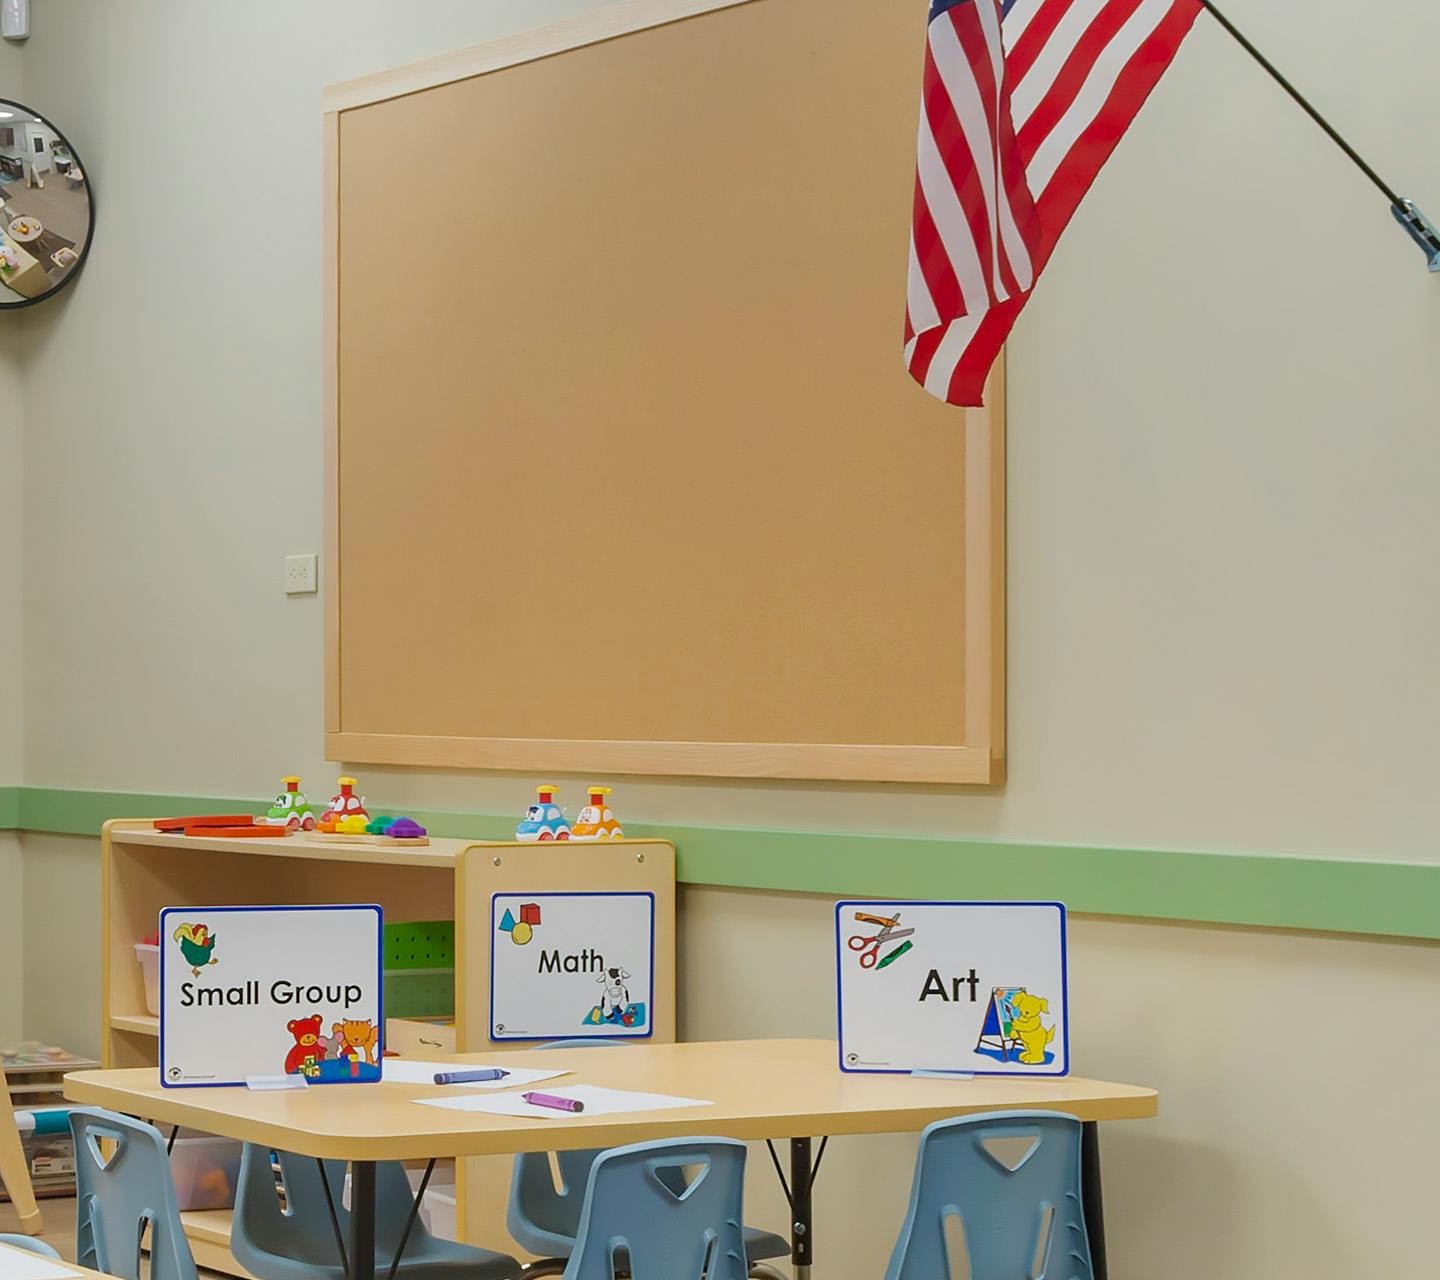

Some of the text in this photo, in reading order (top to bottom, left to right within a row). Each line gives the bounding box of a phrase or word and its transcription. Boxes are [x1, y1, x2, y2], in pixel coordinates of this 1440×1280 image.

[538, 946, 606, 974] Math
[180, 978, 363, 1012] Small Group
[919, 967, 979, 1003] Art
